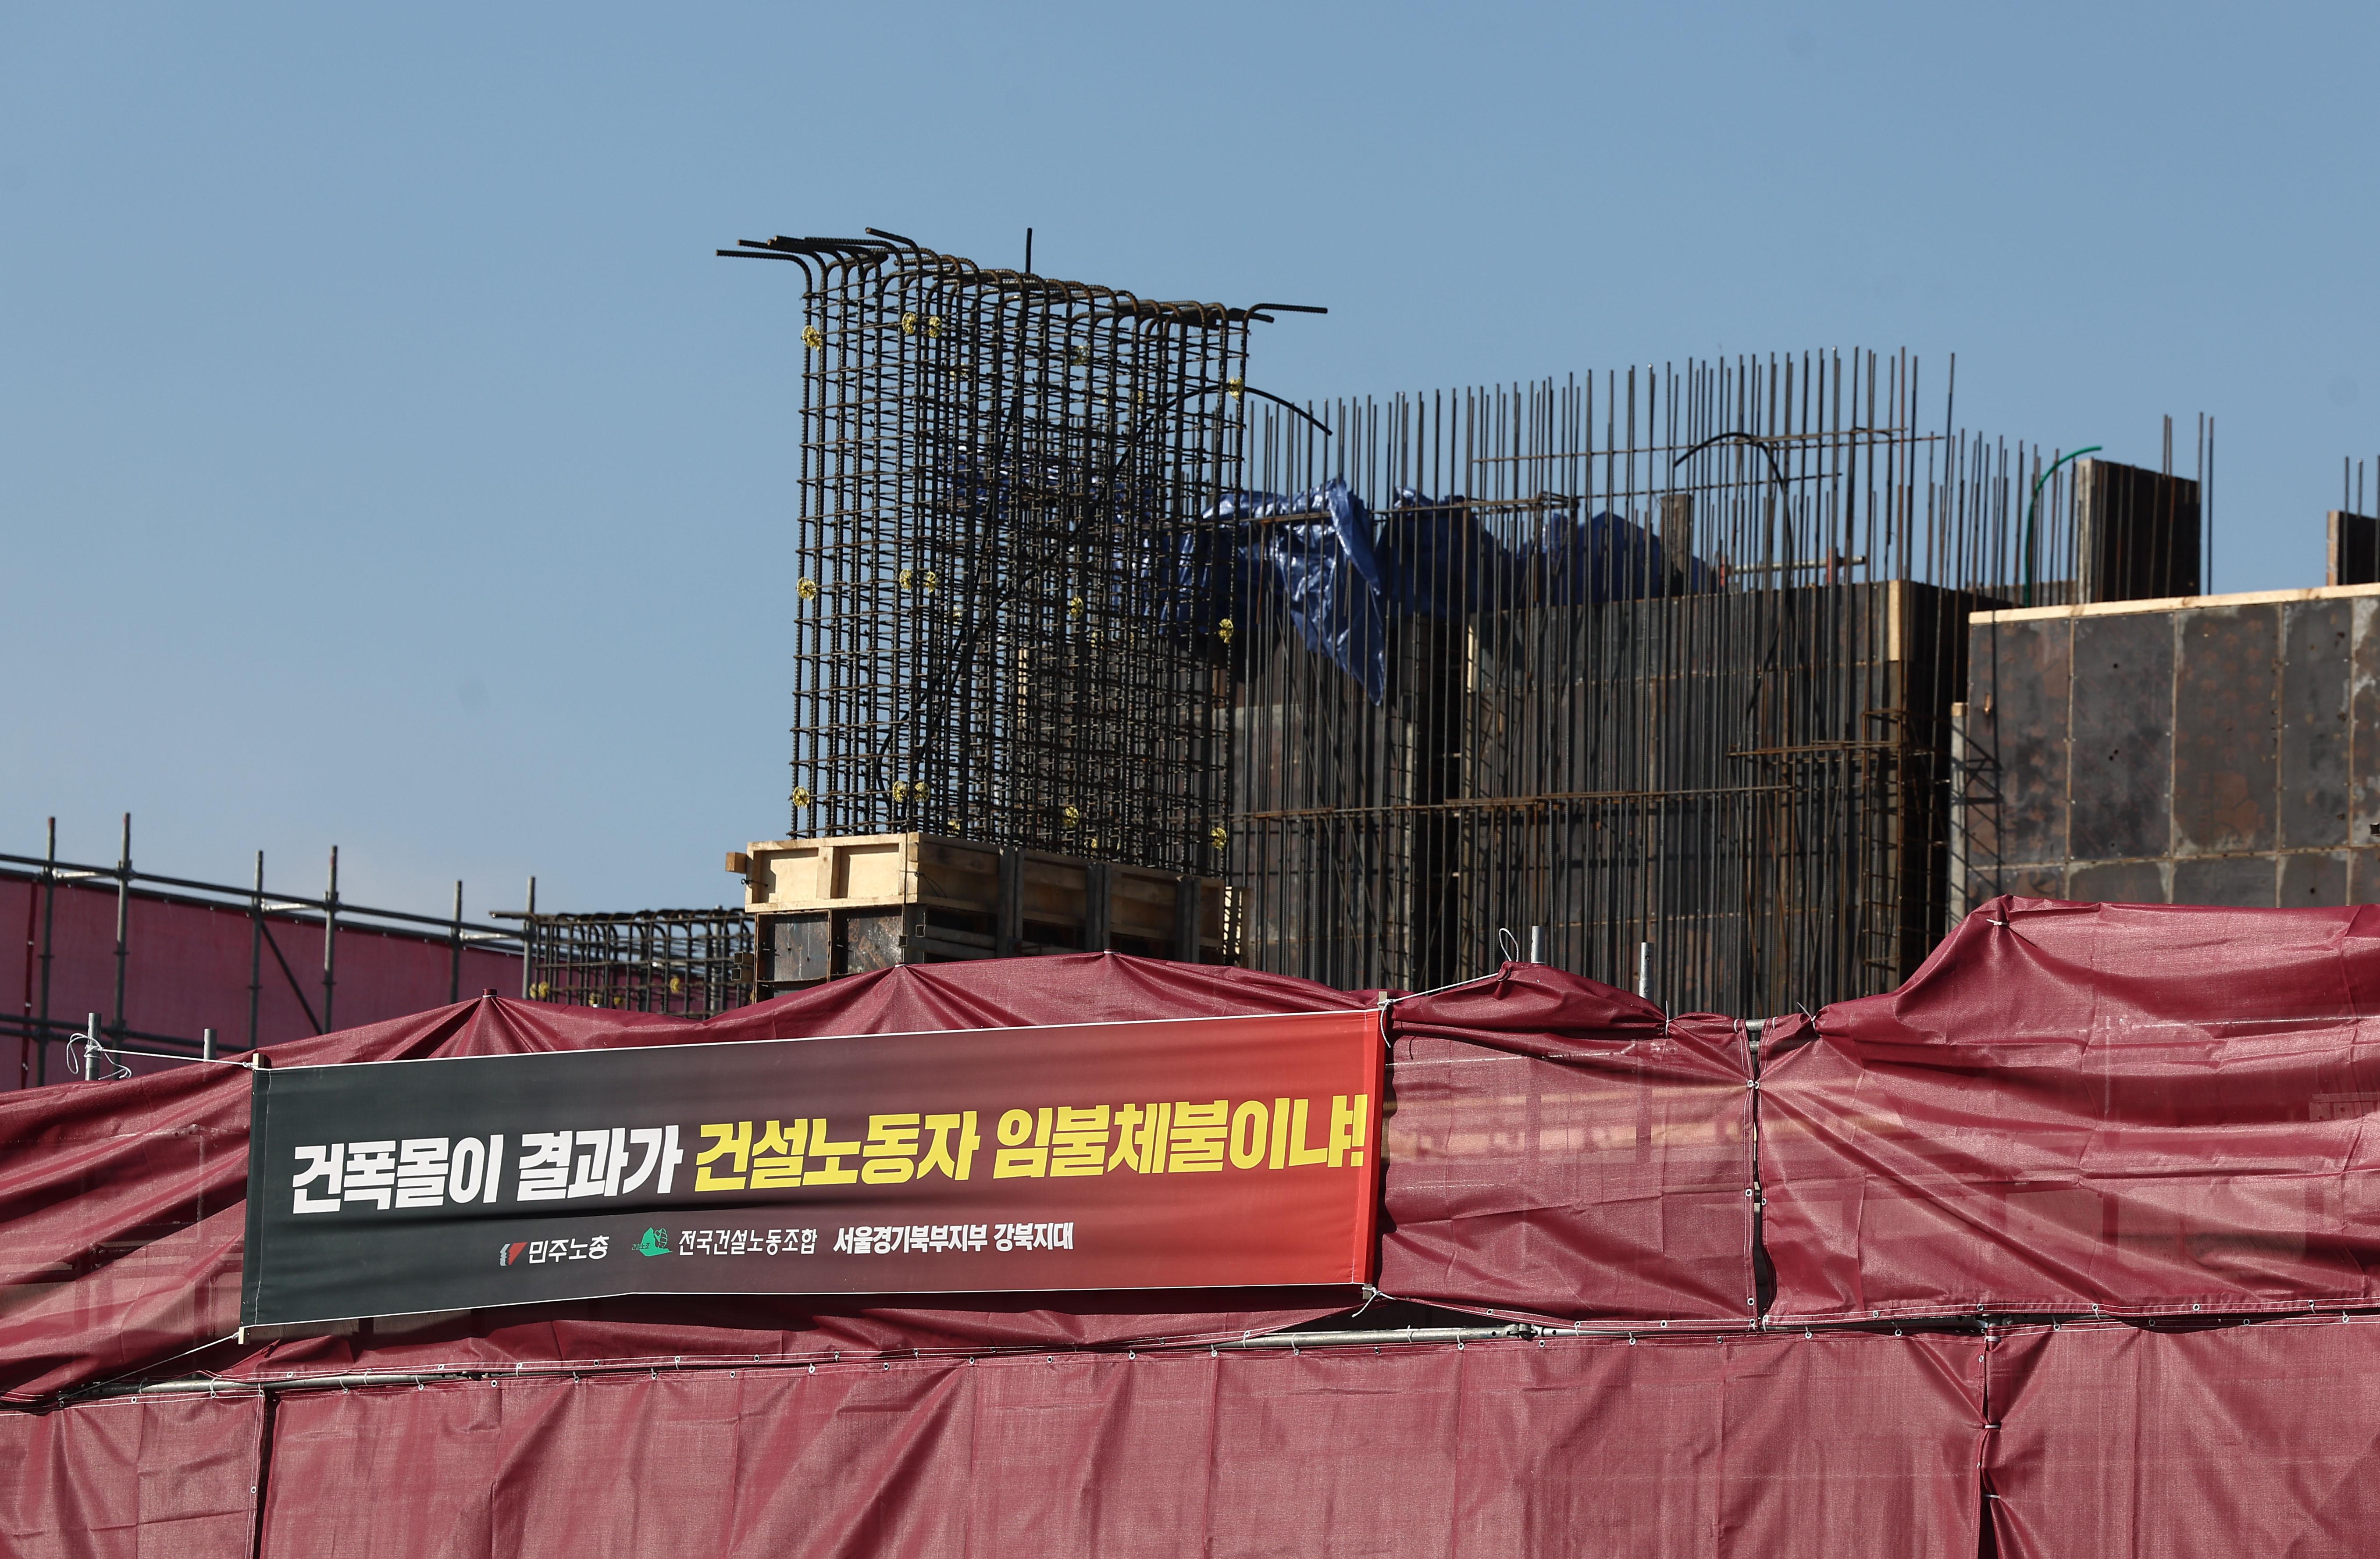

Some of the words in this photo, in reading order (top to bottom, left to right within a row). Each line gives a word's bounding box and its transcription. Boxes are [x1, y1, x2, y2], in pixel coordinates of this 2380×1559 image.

[292, 1134, 504, 1214] 건폭몰이
[517, 1125, 684, 1201] 결과가
[695, 1111, 981, 1192] 건설노동자
[993, 1094, 1368, 1179] 임불체불이냐!
[529, 1235, 609, 1264] 민주노총
[679, 1228, 818, 1256] 전국건설노동조합
[833, 1224, 988, 1254] 서울경기북부지부
[994, 1222, 1074, 1252] 강북지대
